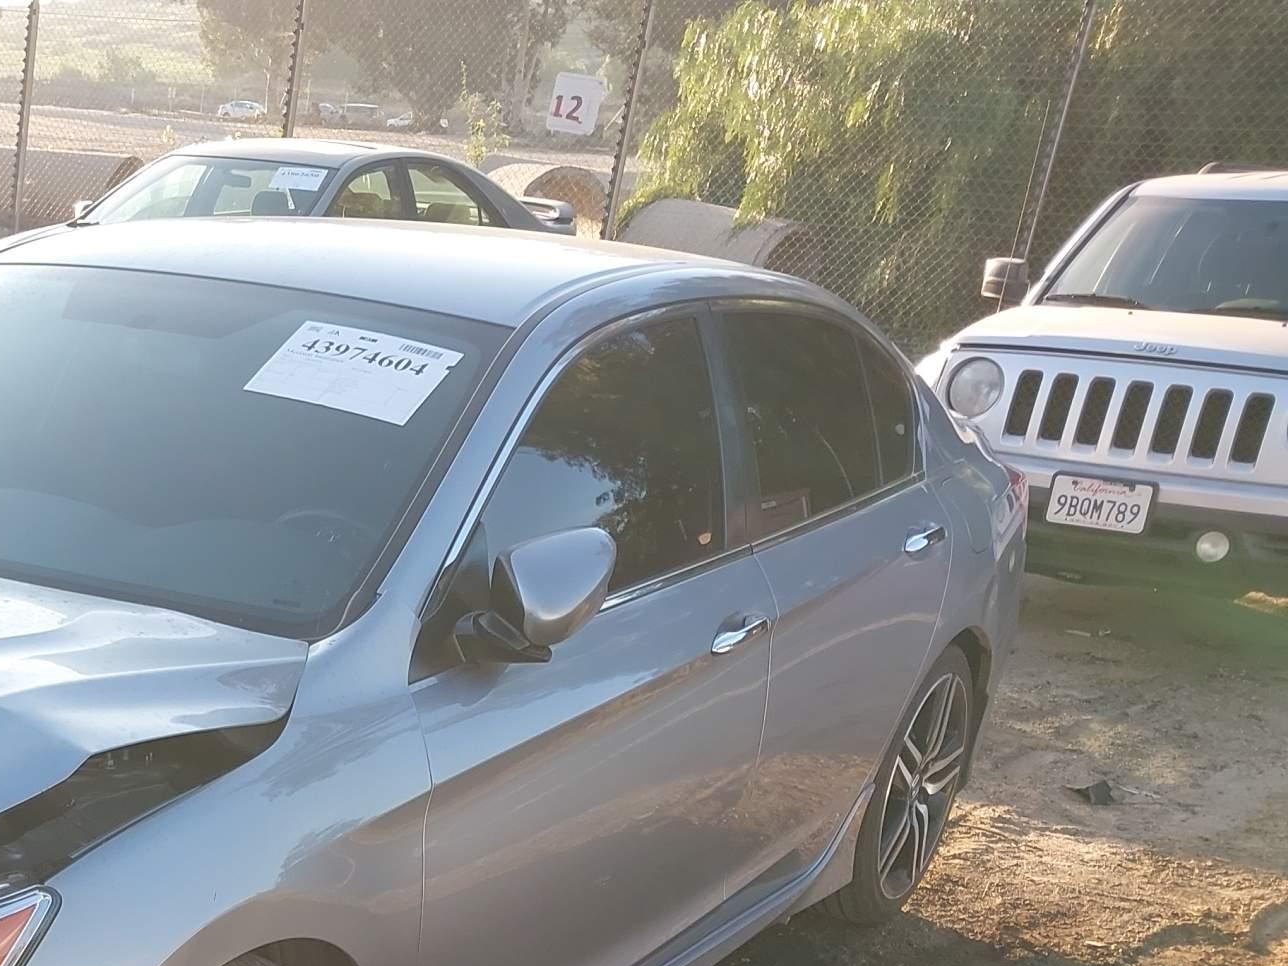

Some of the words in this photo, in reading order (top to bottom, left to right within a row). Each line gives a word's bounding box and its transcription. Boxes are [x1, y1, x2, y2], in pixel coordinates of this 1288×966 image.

[552, 95, 583, 124] 12
[301, 339, 429, 375] 43974604
[1133, 339, 1177, 356] Jeep
[1054, 494, 1141, 525] 9BQM789
